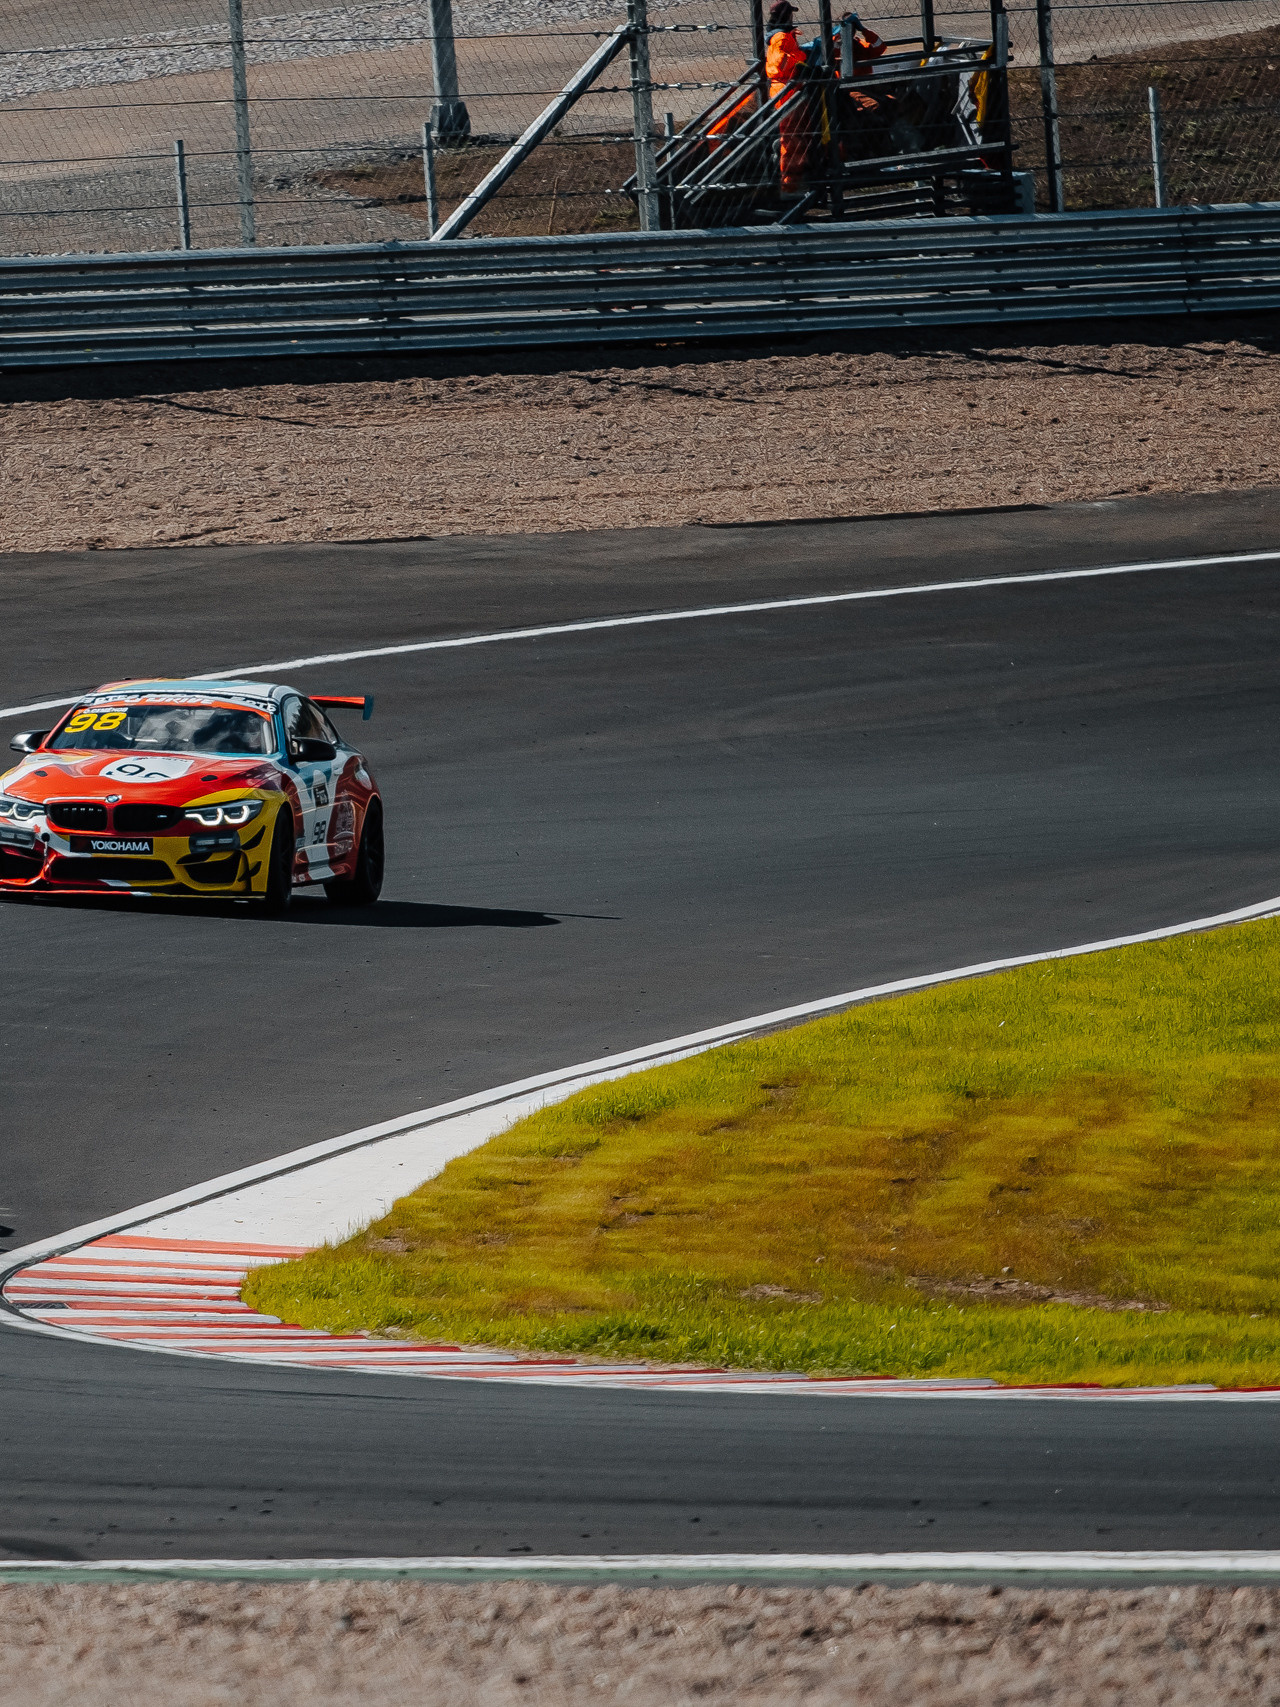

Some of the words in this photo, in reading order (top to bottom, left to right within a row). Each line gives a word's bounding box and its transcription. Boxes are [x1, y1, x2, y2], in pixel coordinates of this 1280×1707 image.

[64, 712, 127, 733] 98
[313, 820, 326, 845] 98
[91, 840, 150, 851] YOKOHAMA
